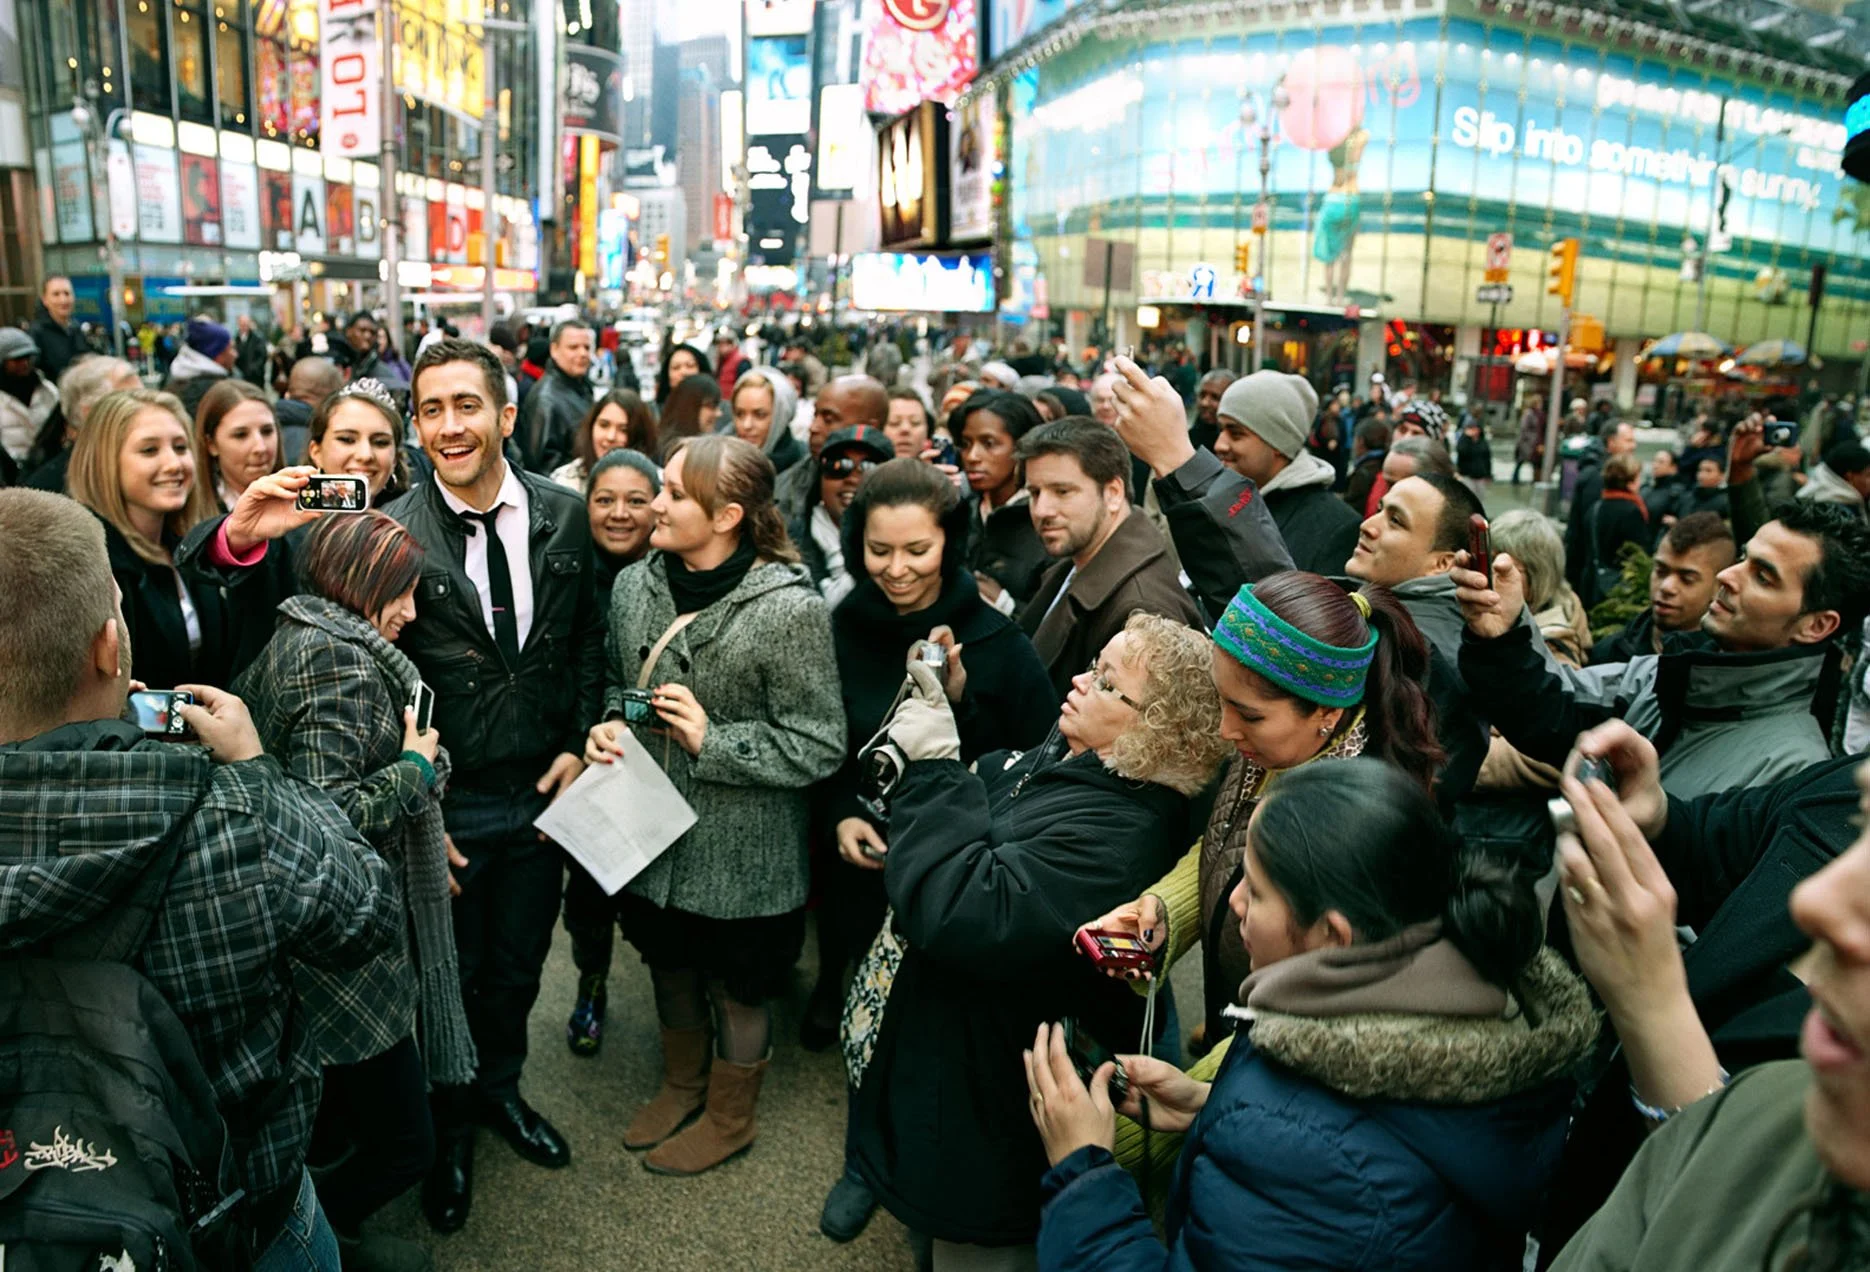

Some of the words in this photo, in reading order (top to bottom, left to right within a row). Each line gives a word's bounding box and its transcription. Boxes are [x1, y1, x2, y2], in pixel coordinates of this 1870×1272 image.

[1452, 106, 1516, 159] Slip
[1524, 119, 1584, 165] into
[300, 189, 322, 238] A
